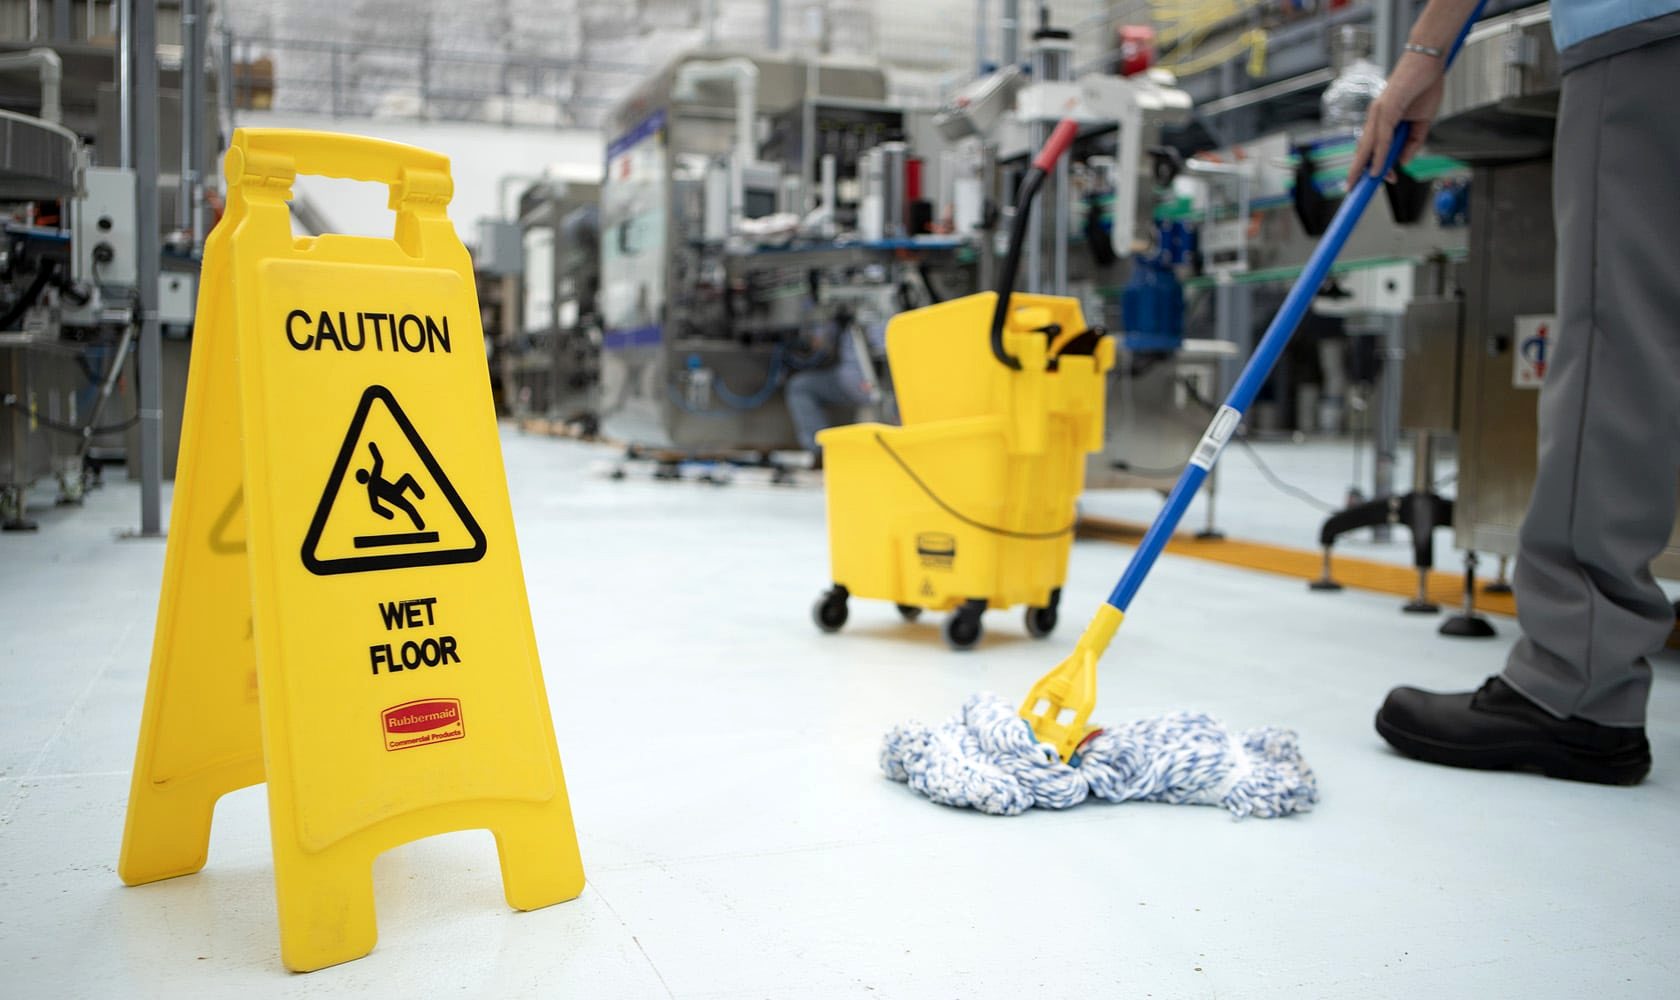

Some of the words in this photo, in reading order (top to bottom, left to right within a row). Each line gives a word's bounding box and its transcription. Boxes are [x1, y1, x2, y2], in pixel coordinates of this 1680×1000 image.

[285, 309, 452, 353] CAUTION
[378, 597, 437, 630] WET
[369, 635, 461, 675] FLOOR
[388, 708, 456, 728] Rubbermaid
[389, 734, 430, 747] Commercial
[431, 730, 461, 740] Products
